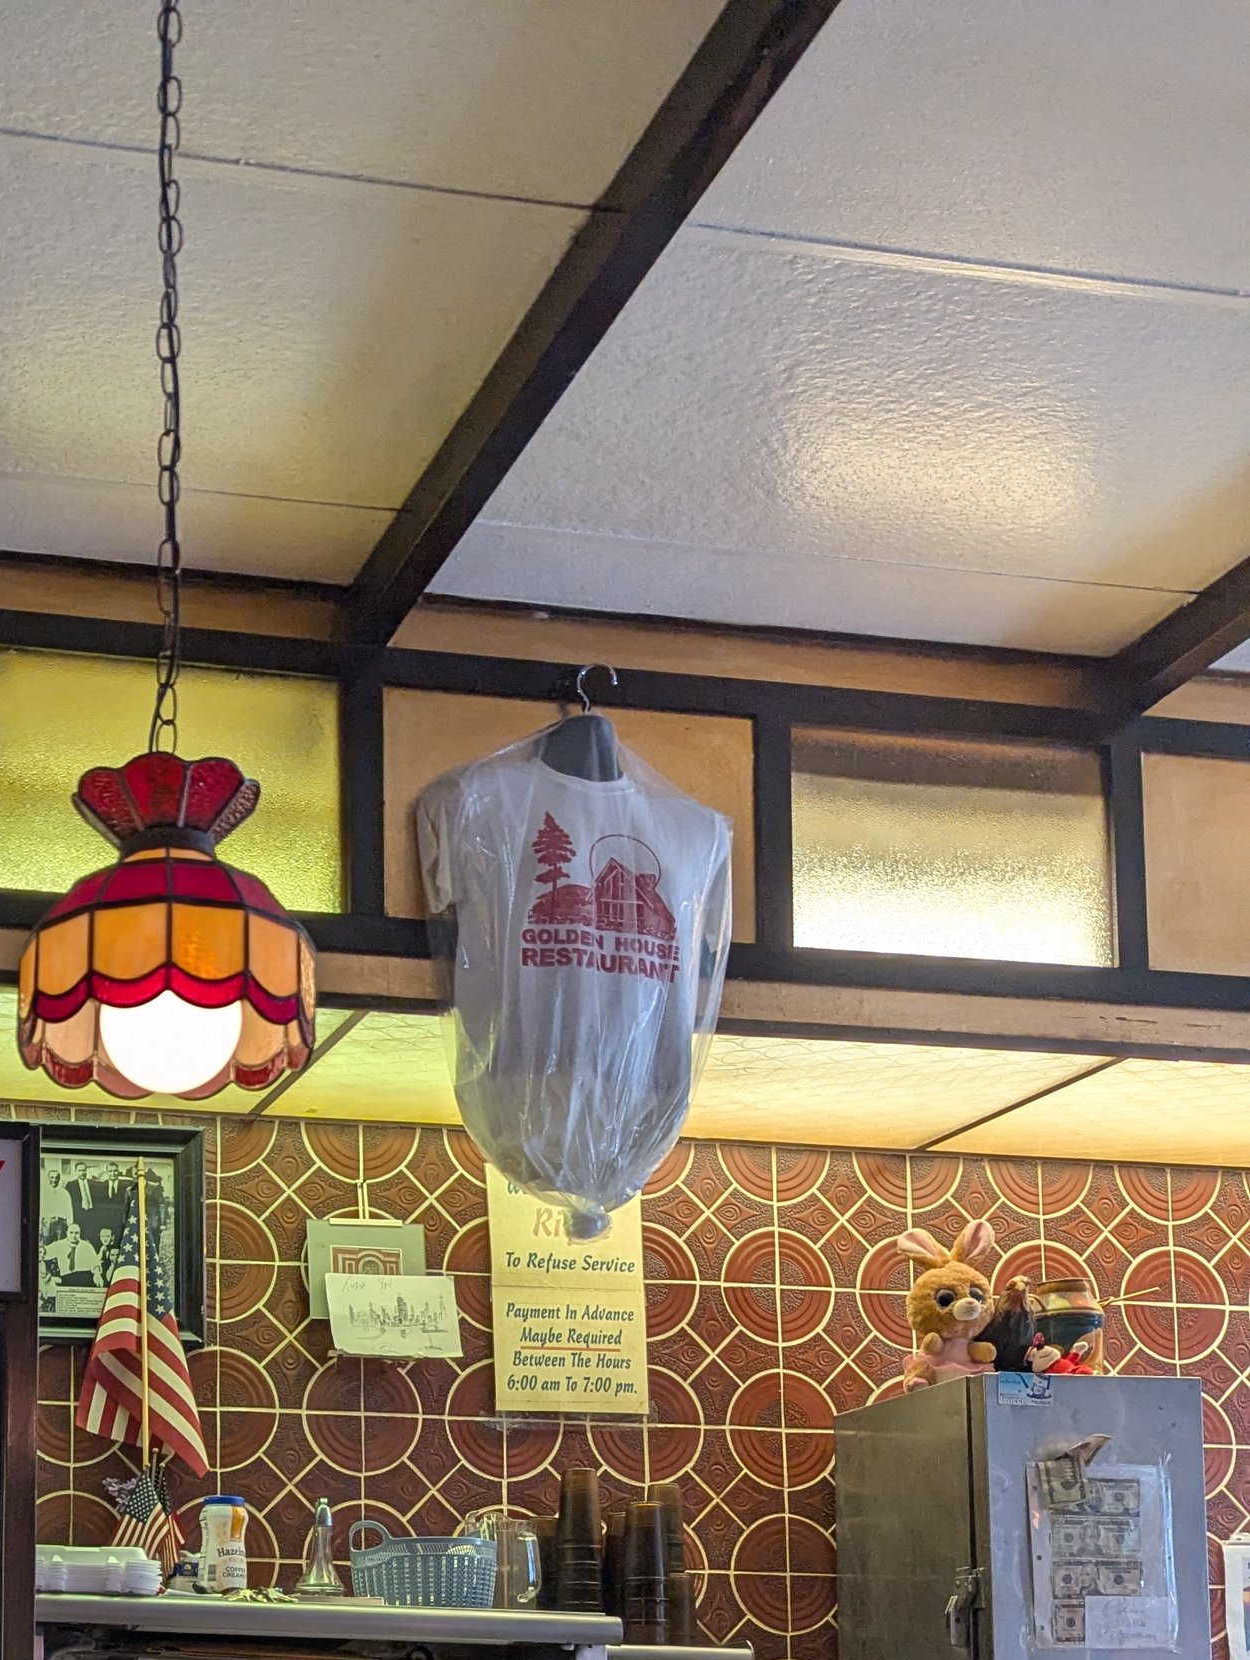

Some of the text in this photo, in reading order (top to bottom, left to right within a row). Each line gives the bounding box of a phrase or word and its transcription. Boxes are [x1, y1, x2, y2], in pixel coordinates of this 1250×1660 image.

[521, 928, 680, 962] GOLDEN HOUSE
[521, 947, 680, 984] RESTAURANT
[505, 1251, 636, 1274] To Refuse Service
[505, 1302, 635, 1323] Payment In Advance
[519, 1327, 623, 1349] Maybe Required
[512, 1351, 632, 1370] Between The Hours
[506, 1374, 638, 1397] 6:00 am To 7:00 pm.
